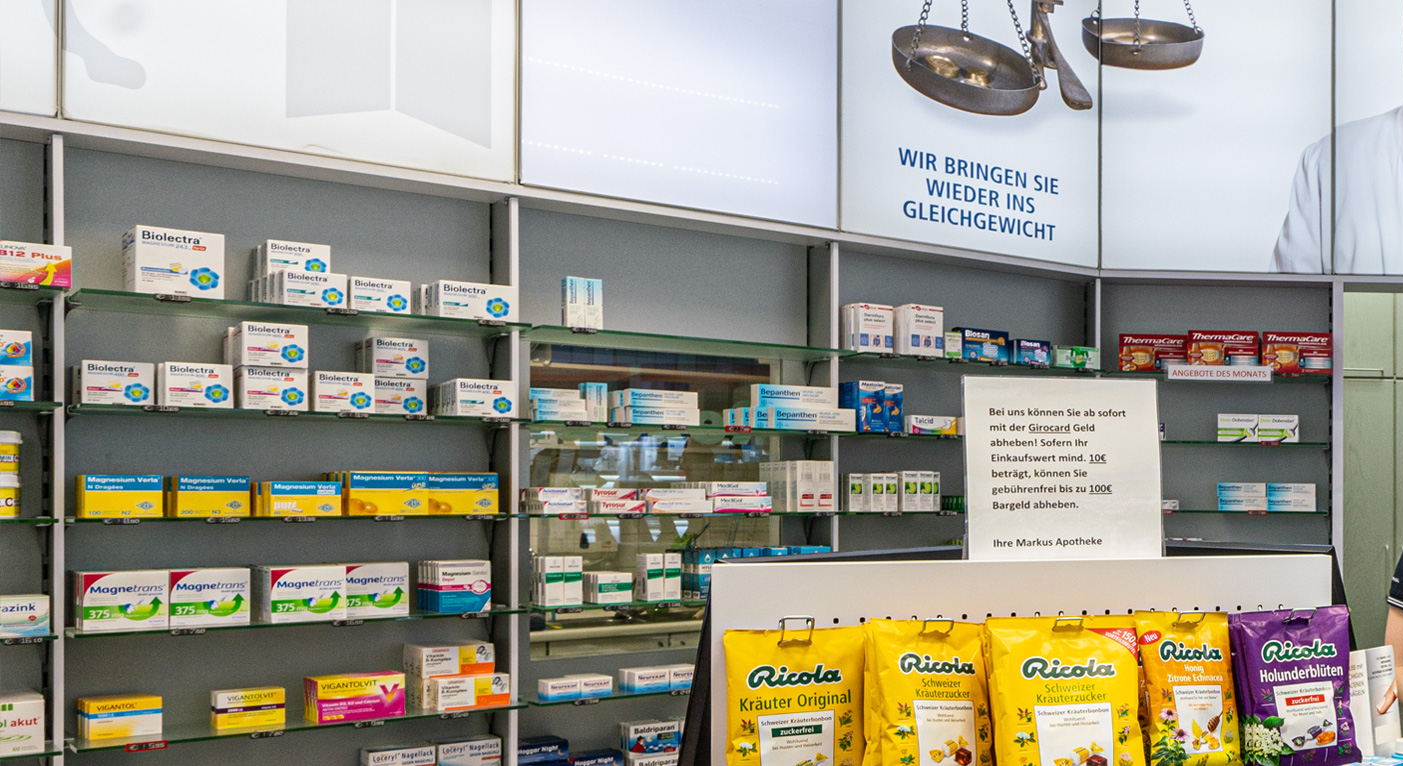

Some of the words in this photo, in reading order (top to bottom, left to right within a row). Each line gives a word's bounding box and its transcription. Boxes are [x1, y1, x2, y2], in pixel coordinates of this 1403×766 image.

[898, 147, 937, 172] WIR
[944, 156, 1027, 189] BRINGEN
[1034, 175, 1059, 195] SIE
[926, 178, 1000, 208] WIEDER
[1006, 192, 1035, 214] INS
[902, 200, 1056, 241] GLEICHGEWICHT
[142, 231, 200, 245] Biolectra
[31, 252, 62, 260] Plus
[1123, 336, 1184, 345] ThermaCare
[1192, 332, 1254, 341] ThermaCare
[87, 364, 135, 373] Biolectra
[1172, 370, 1214, 378] ANGEBOTE
[1232, 370, 1267, 378] MONATS
[989, 408, 1004, 416] Bei
[1028, 408, 1064, 417] können
[1066, 408, 1080, 417] Sie
[1084, 409, 1096, 417] ab
[1098, 409, 1126, 418] sofort
[914, 417, 934, 425] Talcid
[990, 424, 1006, 432] mit
[1009, 424, 1026, 432] der
[1028, 424, 1070, 433] Girocard
[1073, 424, 1095, 432] Geld
[990, 438, 1038, 447] abheben!
[1040, 439, 1072, 447] Sofern
[1074, 439, 1088, 447] Ihr
[991, 454, 1056, 462] Einkaufswert
[1058, 454, 1086, 462] mind.
[1089, 454, 1106, 464] 10€
[992, 469, 1031, 479] beträgt,
[1034, 469, 1070, 478] können
[1073, 470, 1088, 478] Sie
[992, 484, 1057, 495] gebührenfrei
[1059, 485, 1073, 493] bis
[1089, 484, 1112, 494] 100€
[602, 501, 627, 510] Tyrosur
[992, 501, 1030, 511] Bargeld
[1033, 501, 1079, 510] abheben.
[993, 539, 1013, 548] Ihre
[1016, 538, 1053, 547] Markus
[1056, 537, 1102, 548] Apotheke
[176, 582, 245, 592] Magnetrans
[277, 579, 342, 589] Magnetrans
[90, 584, 164, 595] Magnetrans
[175, 606, 195, 615] 375
[276, 603, 295, 612] 375
[88, 609, 110, 619] 375
[1144, 632, 1158, 642] Neu
[1159, 640, 1223, 662] Ricola
[1262, 640, 1337, 662] Ricola
[899, 652, 976, 675] Ricola
[1021, 657, 1117, 680] Ricola
[1184, 664, 1204, 673] Honig
[747, 664, 842, 689] Ricola
[1167, 674, 1191, 682] Zitrone
[1193, 674, 1223, 682] Echinacea
[1260, 664, 1343, 683] Holunderblüten
[321, 680, 377, 690] VIGANTOLVIT
[922, 678, 961, 688] Schweizer
[1044, 683, 1095, 693] Schweizer
[915, 689, 970, 698] Kräuterzucker
[1036, 692, 1107, 703] Kräuterzucker
[740, 696, 792, 712] Kräuter
[797, 689, 851, 709] Original
[1291, 696, 1320, 705] zuckerfrei
[97, 703, 135, 711] VIGANTOL
[10, 717, 38, 728] akut
[790, 716, 832, 724] Kräuterbonbon
[634, 724, 675, 734] Baldriparan
[780, 726, 814, 736] zuckerfrei
[402, 750, 433, 759] Nagellack
